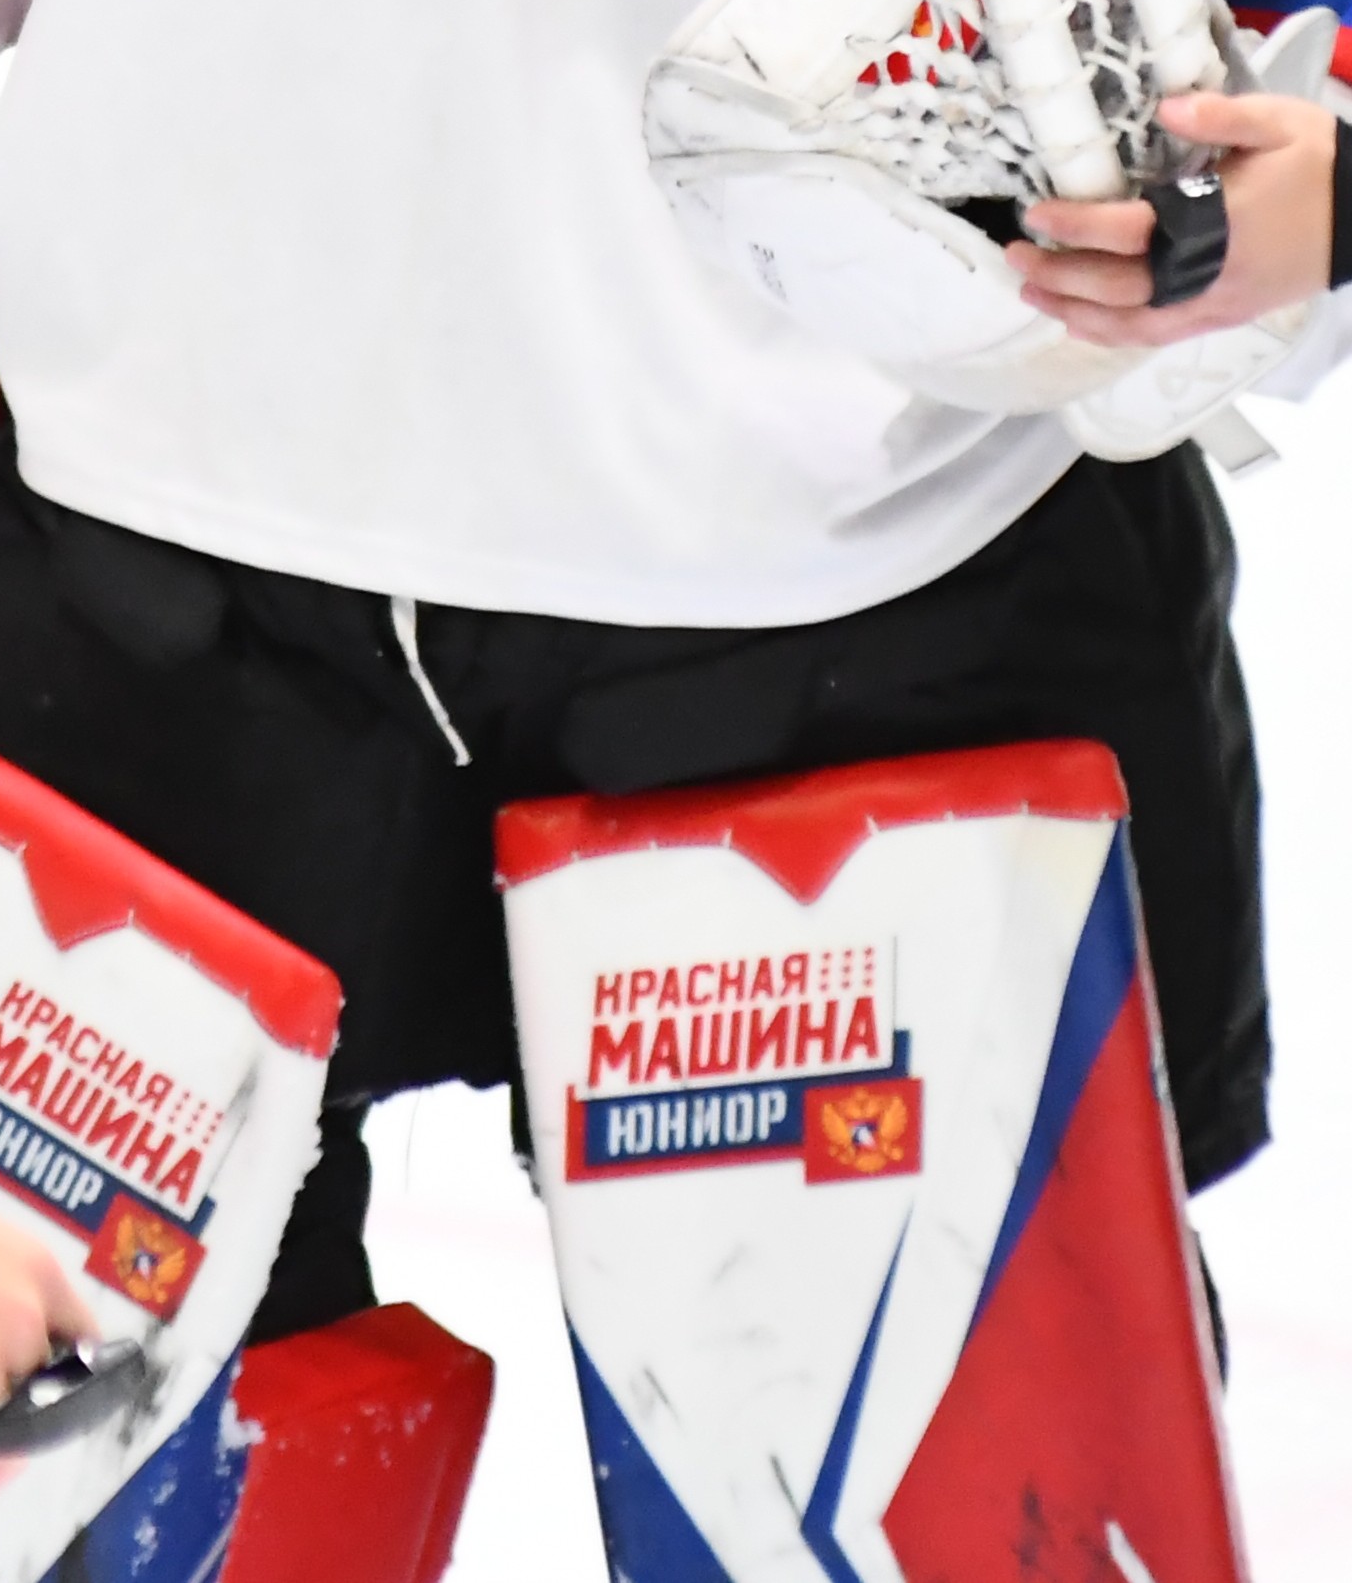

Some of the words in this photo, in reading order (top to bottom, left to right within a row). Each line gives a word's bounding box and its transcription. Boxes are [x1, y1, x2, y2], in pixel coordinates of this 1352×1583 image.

[594, 952, 809, 1017] КРАСНАЯ
[588, 996, 879, 1088] МАШИНА
[608, 1088, 787, 1157] ЮНИОР
